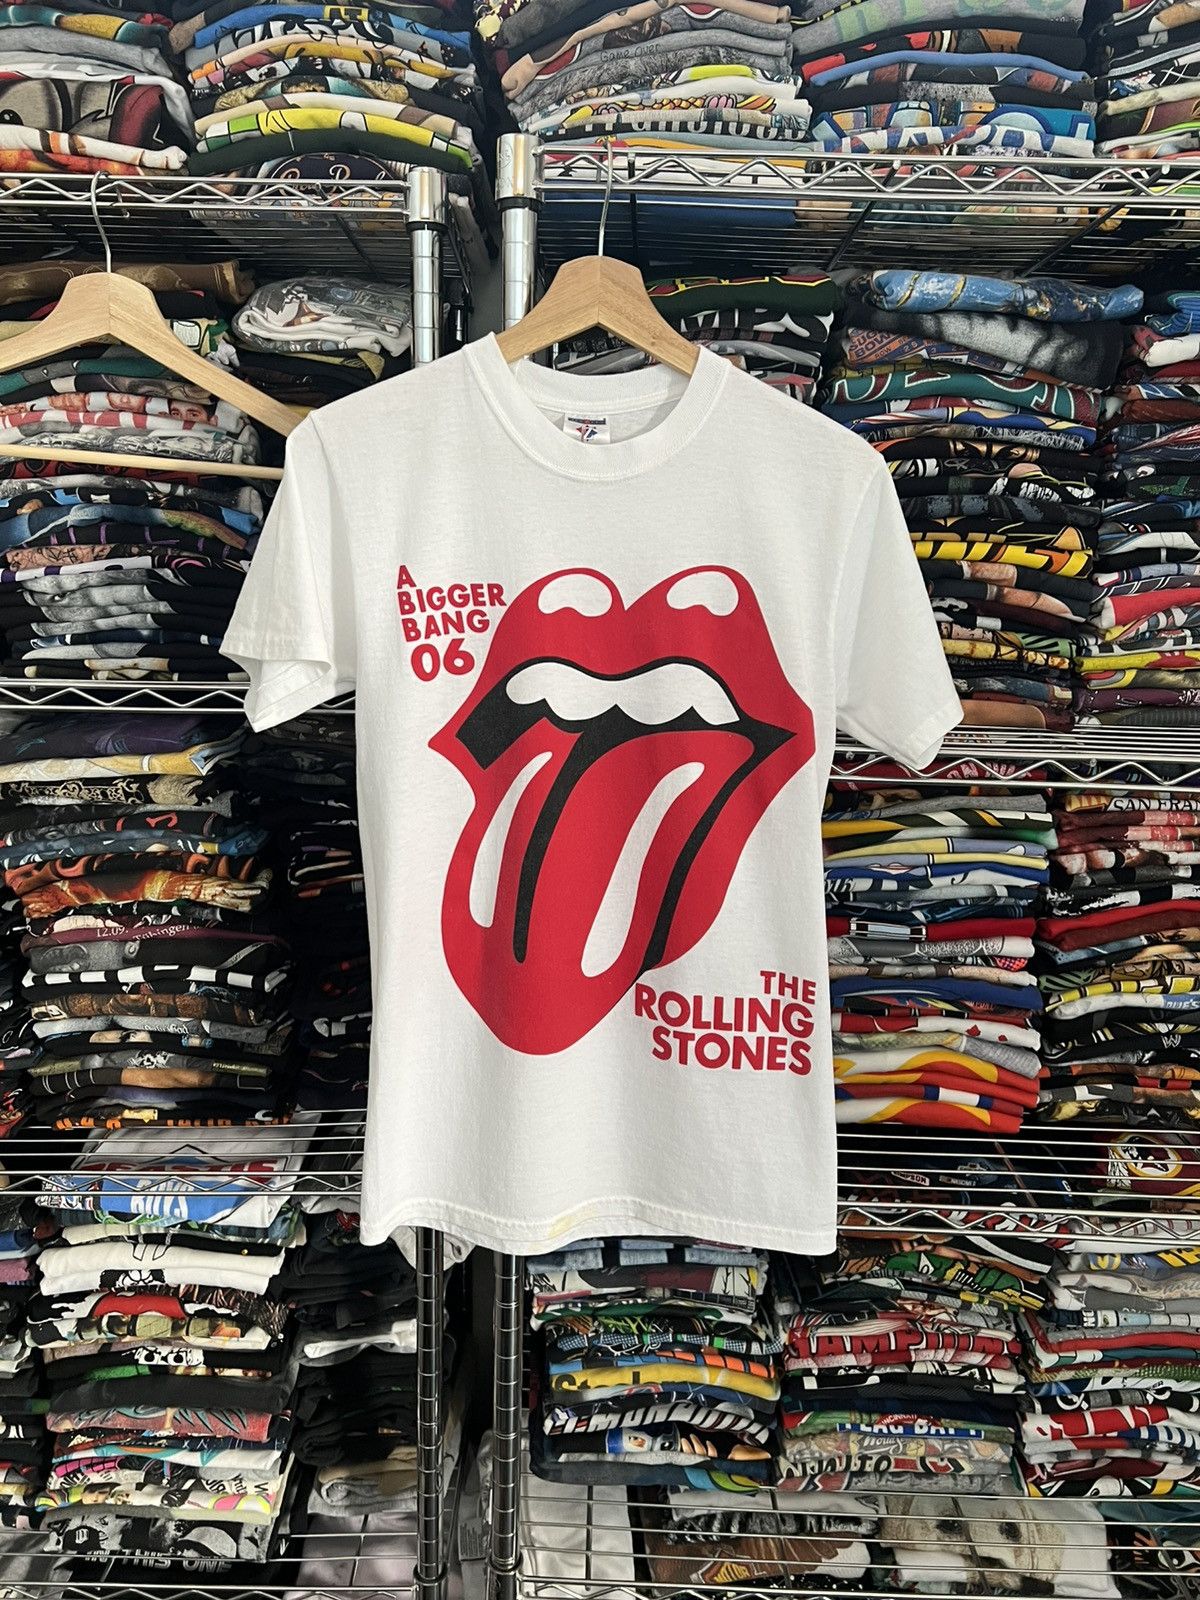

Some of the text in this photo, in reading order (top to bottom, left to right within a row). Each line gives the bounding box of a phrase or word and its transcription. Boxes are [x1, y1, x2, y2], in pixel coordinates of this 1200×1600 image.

[634, 43, 661, 58] Over
[397, 565, 417, 590] A
[397, 583, 507, 615] BIGGER
[402, 609, 490, 642] BANG
[411, 638, 475, 682] 06
[760, 970, 816, 1004] THE
[634, 983, 814, 1038] ROLLING
[652, 1025, 812, 1076] STONES
